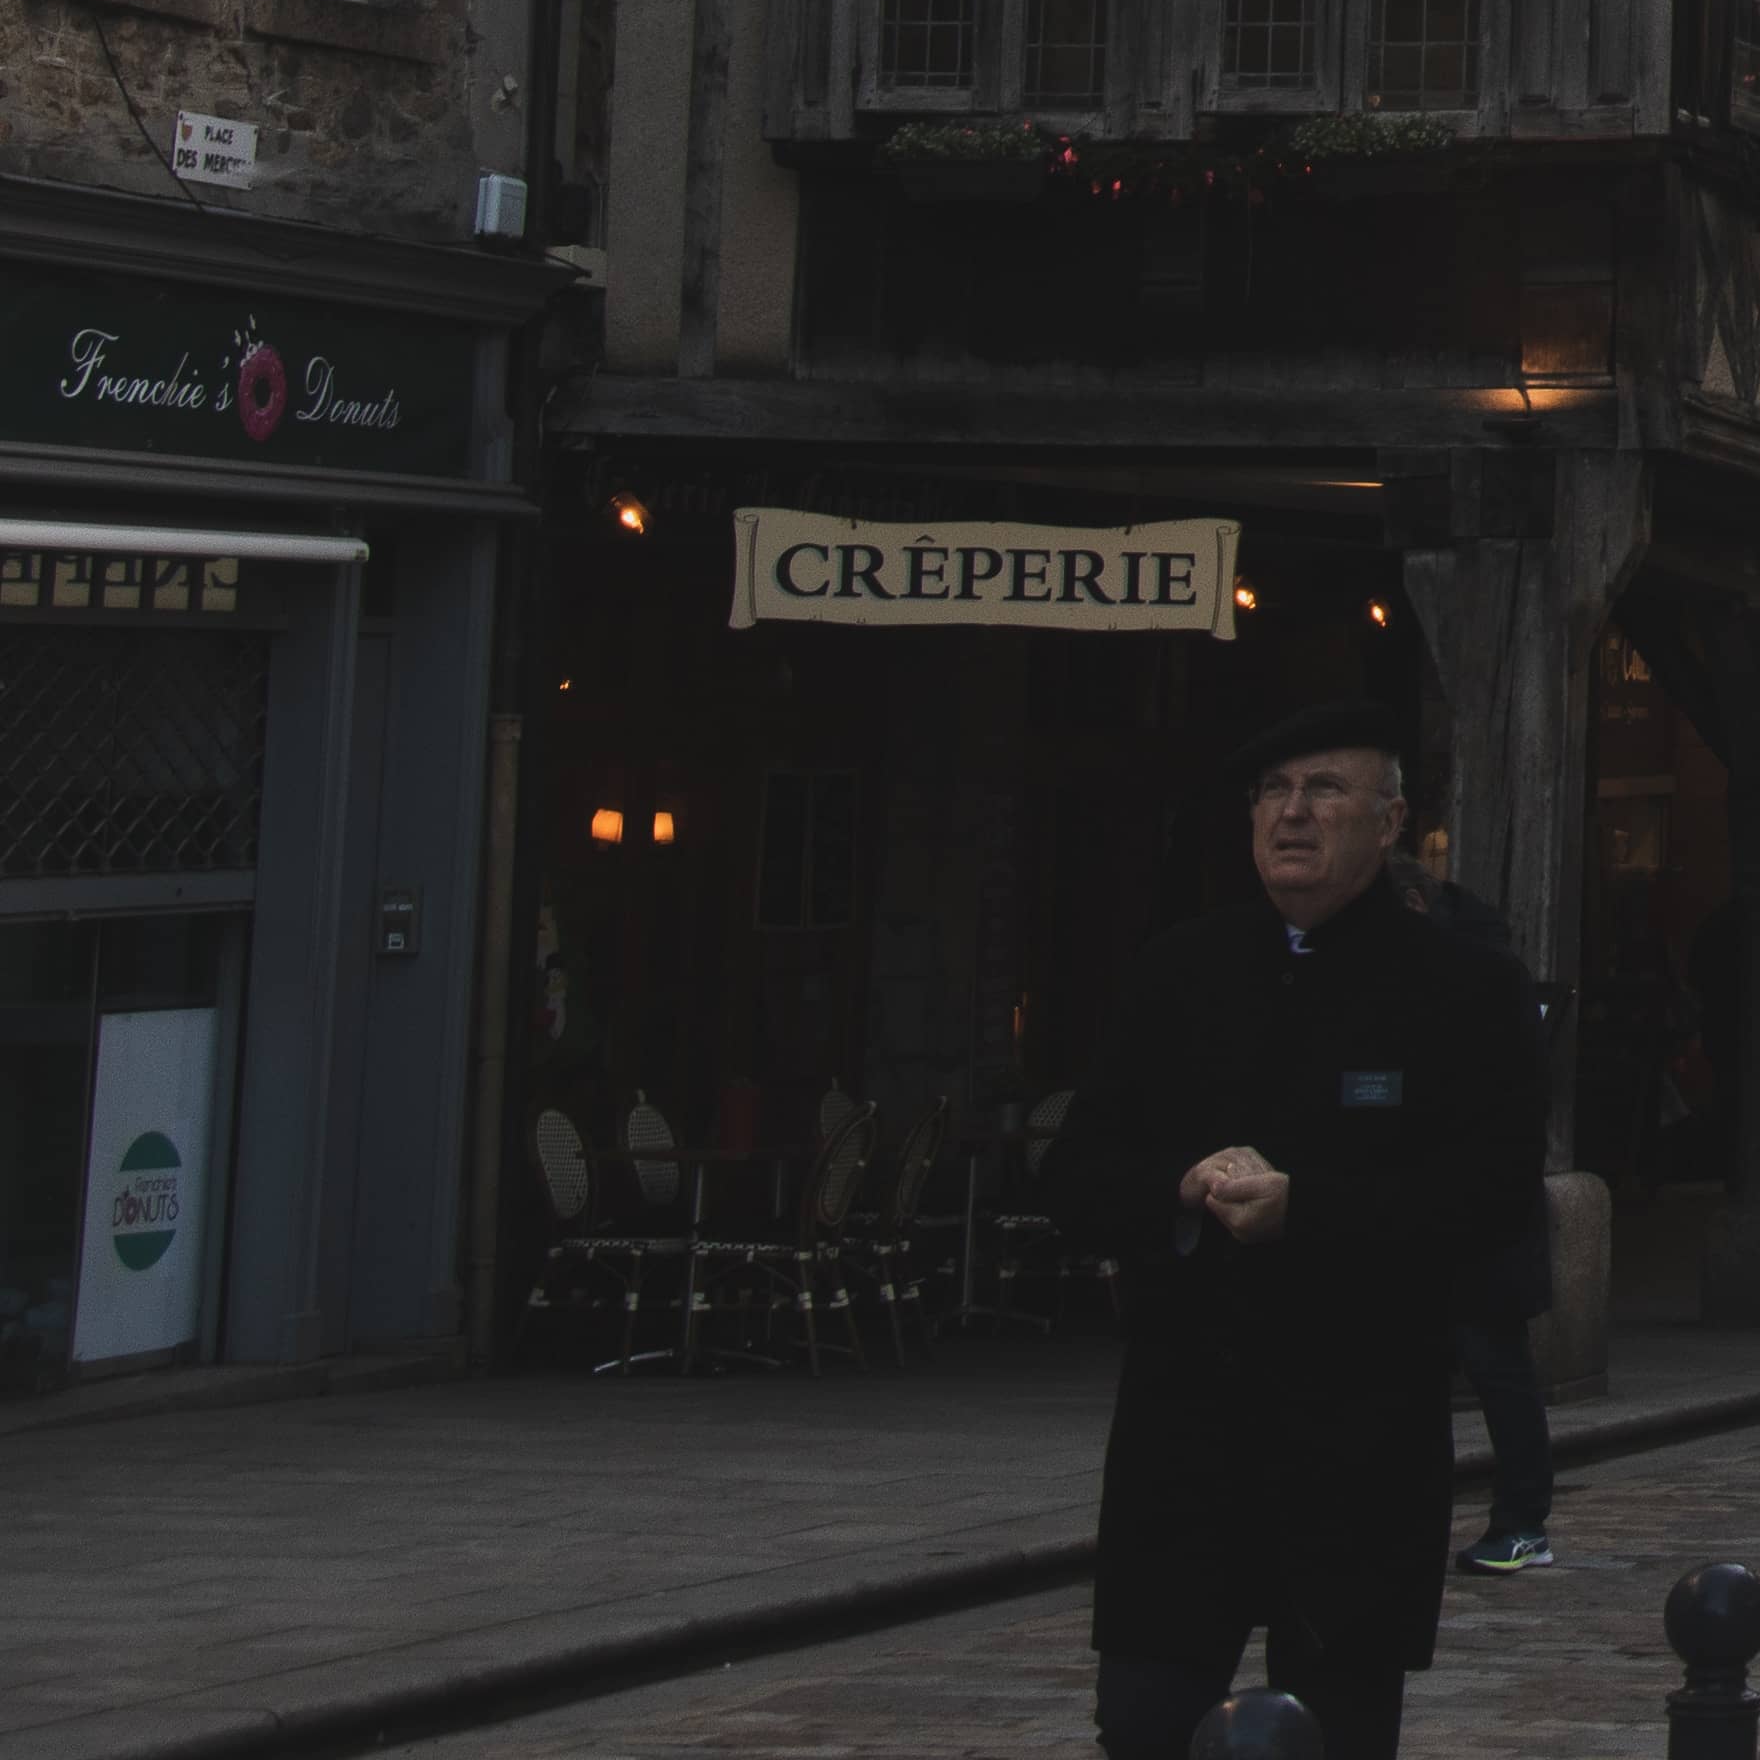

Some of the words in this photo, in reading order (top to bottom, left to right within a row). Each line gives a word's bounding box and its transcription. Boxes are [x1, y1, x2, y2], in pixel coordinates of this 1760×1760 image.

[177, 148, 198, 168] DES
[204, 126, 234, 145] PLACE
[60, 328, 234, 413] Frenchie's
[296, 355, 402, 430] Donuts
[775, 534, 1198, 606] CRÊPERIE
